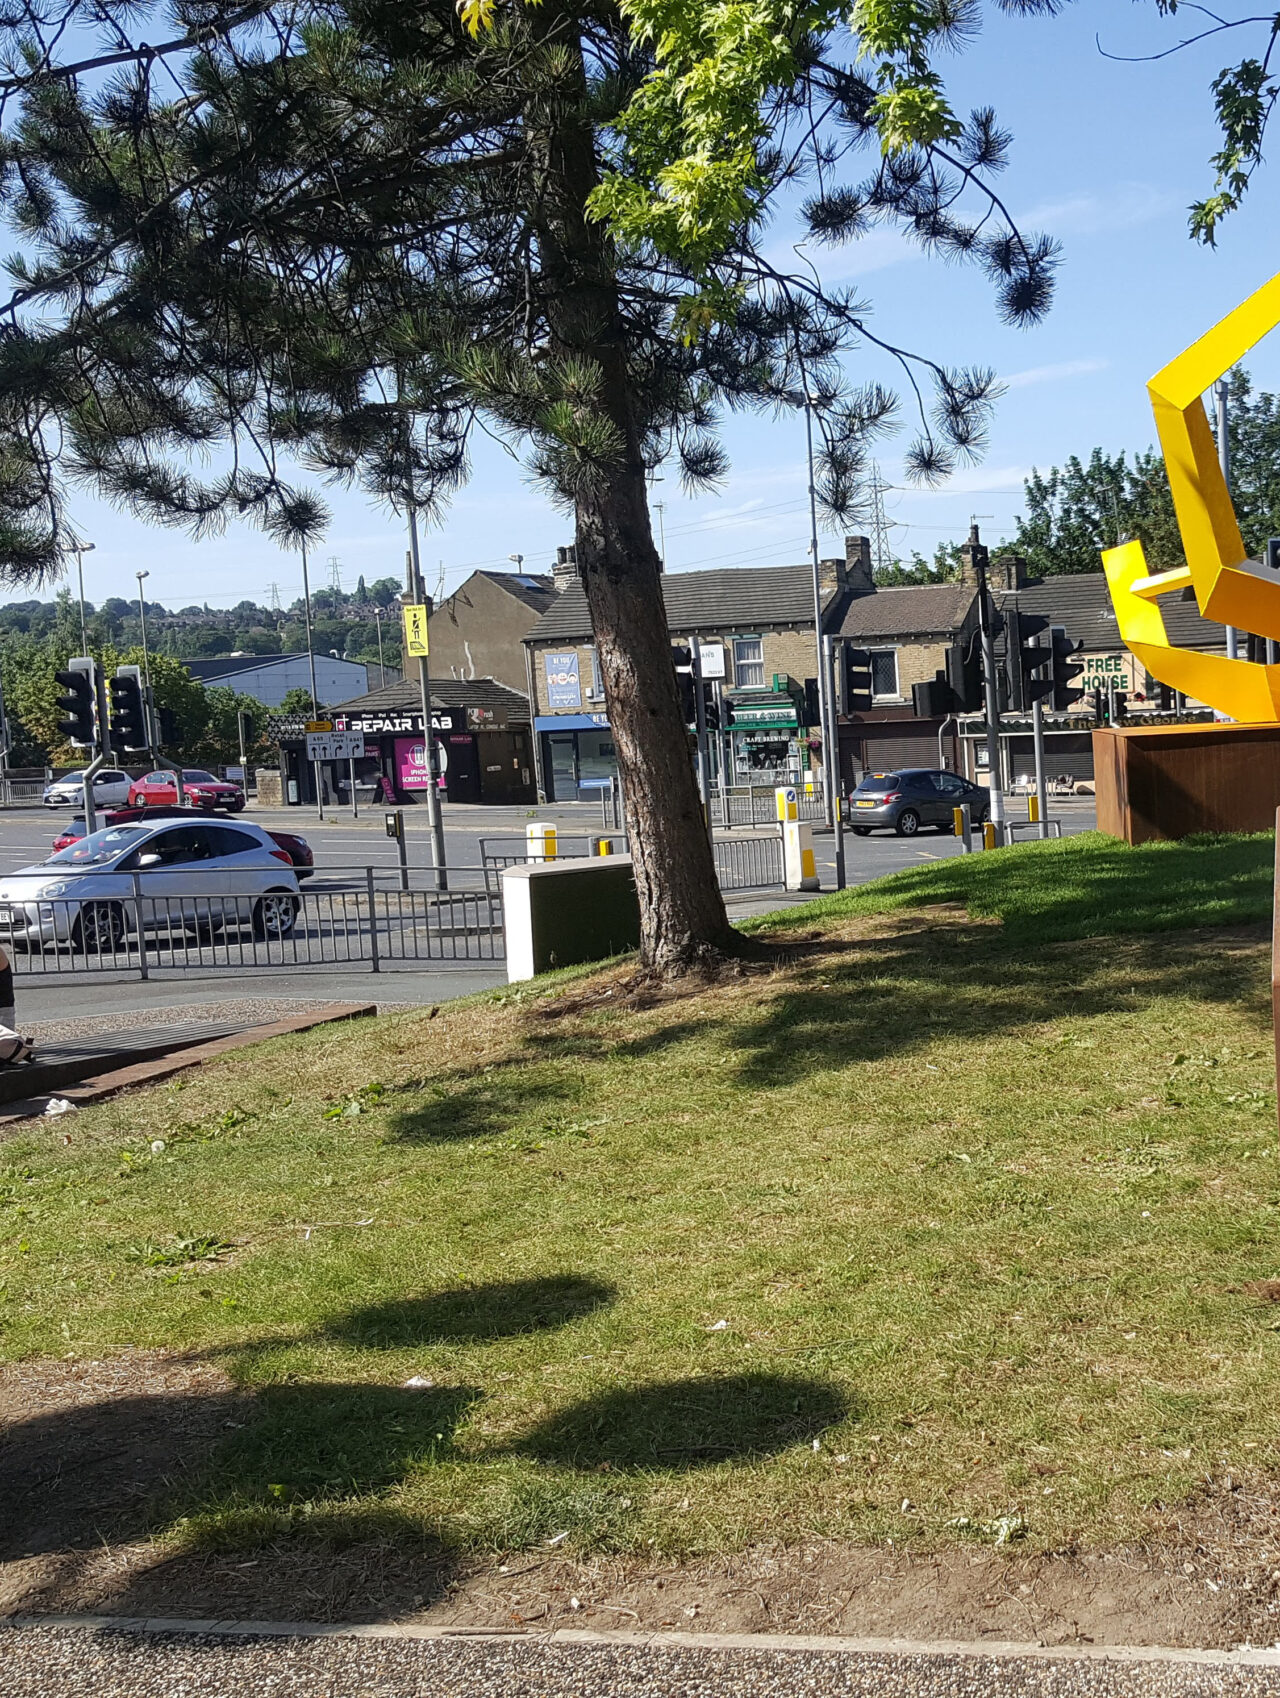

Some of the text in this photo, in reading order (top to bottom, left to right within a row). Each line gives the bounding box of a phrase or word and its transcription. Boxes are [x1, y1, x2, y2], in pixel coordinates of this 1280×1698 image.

[1087, 658, 1121, 673] FREE
[1082, 675, 1128, 690] HOUSE
[351, 716, 452, 732] REPAIR LAB
[1066, 719, 1096, 729] The
